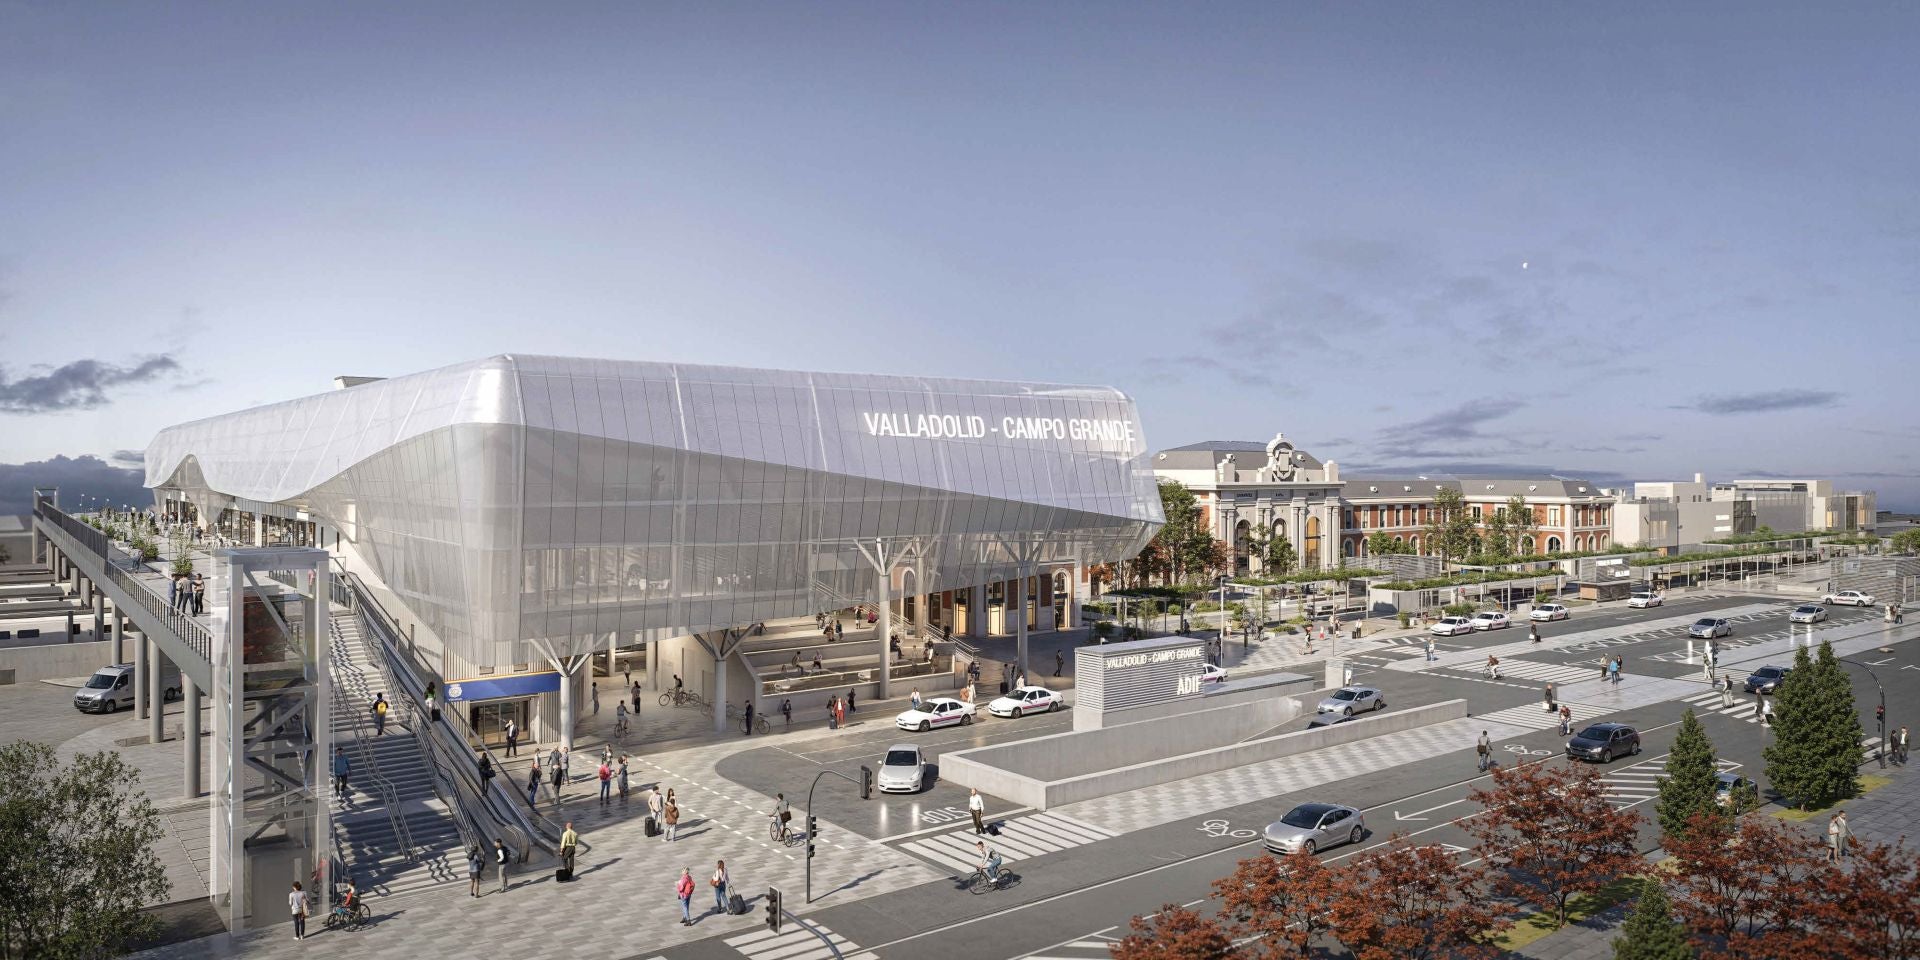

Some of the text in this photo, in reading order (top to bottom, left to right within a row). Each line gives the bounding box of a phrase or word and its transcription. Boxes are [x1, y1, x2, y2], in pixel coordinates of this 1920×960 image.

[863, 412, 985, 438] VALLADOLID
[1003, 416, 1065, 440] CAMPO
[1069, 419, 1136, 442] GRANDE
[1106, 654, 1147, 669] VALLADOLID
[1152, 650, 1176, 663] CAMPO
[1176, 647, 1201, 659] GRANDE
[1177, 675, 1201, 695] ADIF
[918, 806, 972, 824] STOP
